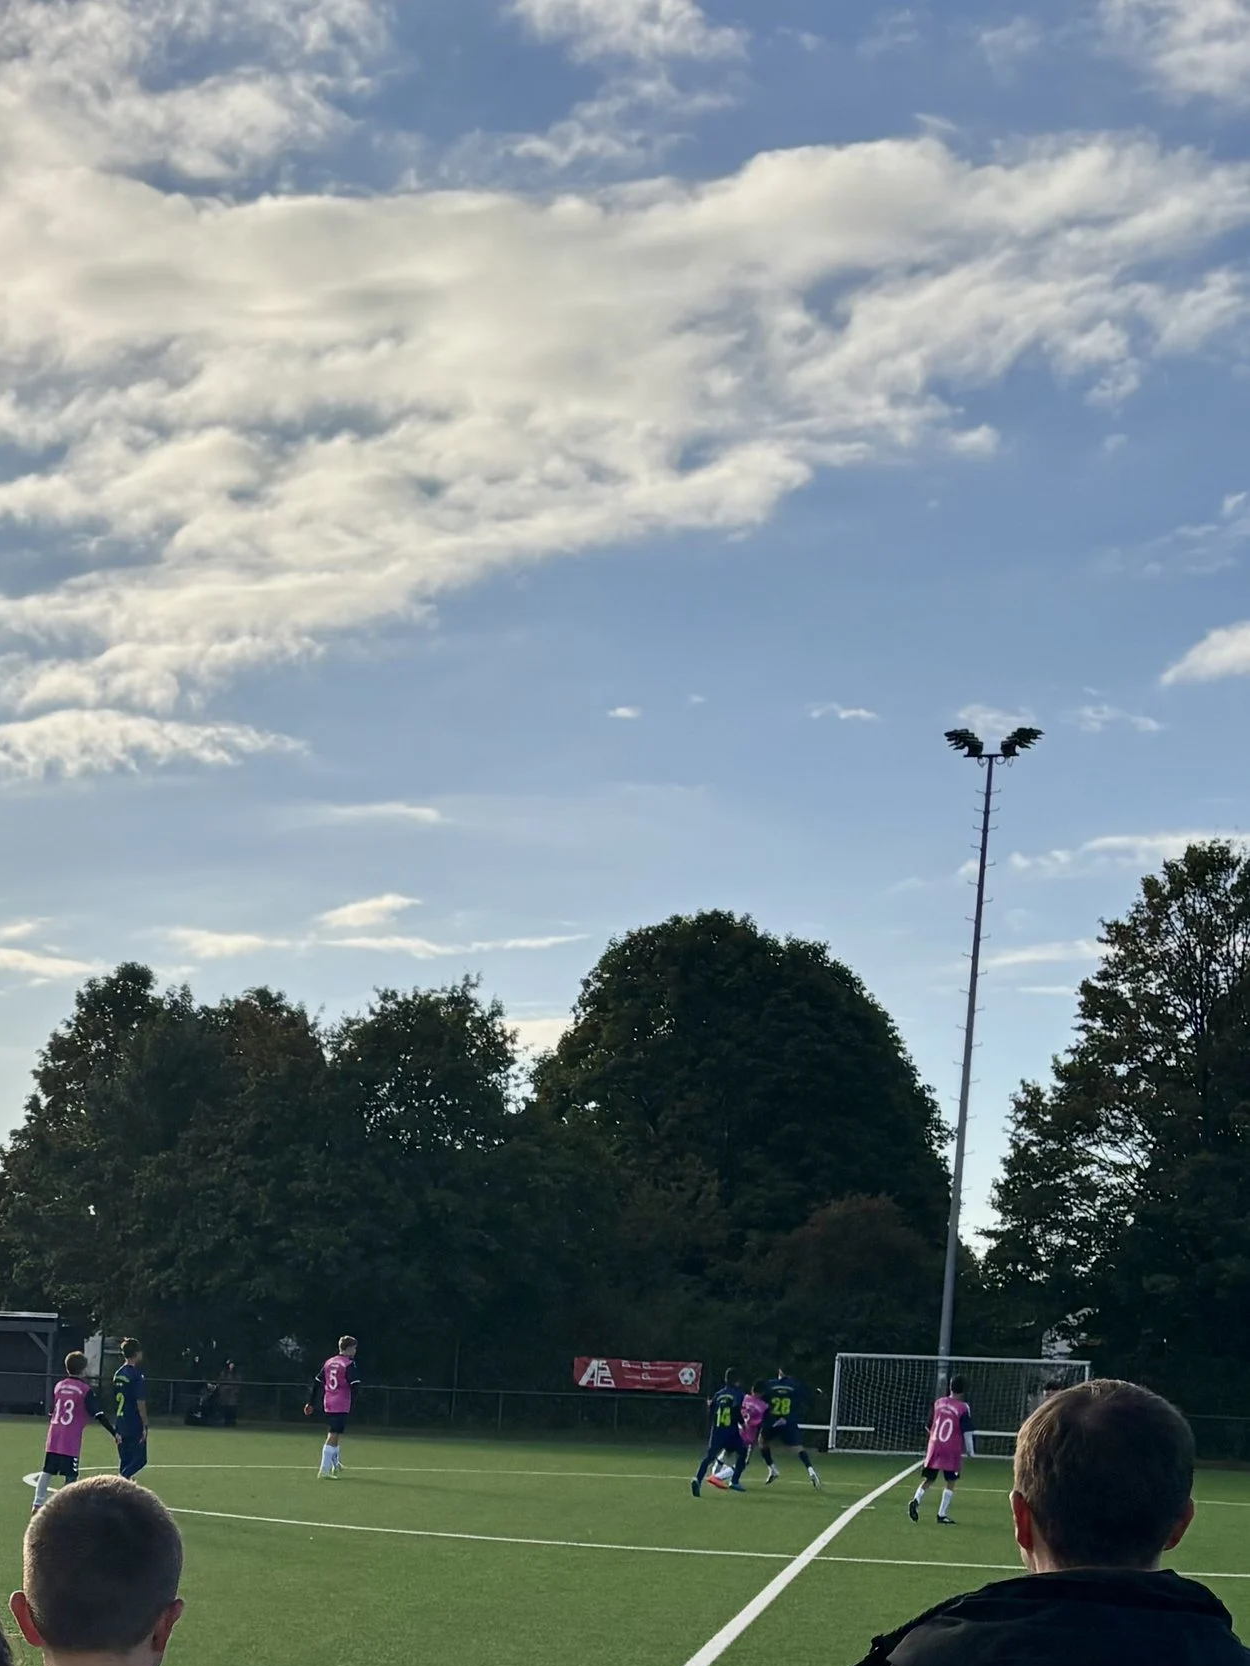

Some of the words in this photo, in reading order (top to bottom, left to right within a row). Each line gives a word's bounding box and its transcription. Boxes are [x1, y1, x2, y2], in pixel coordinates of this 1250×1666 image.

[329, 1369, 338, 1390] 5
[51, 1398, 75, 1425] 13
[116, 1392, 125, 1417] 2
[771, 1397, 791, 1416] 28
[931, 1416, 953, 1442] 10
